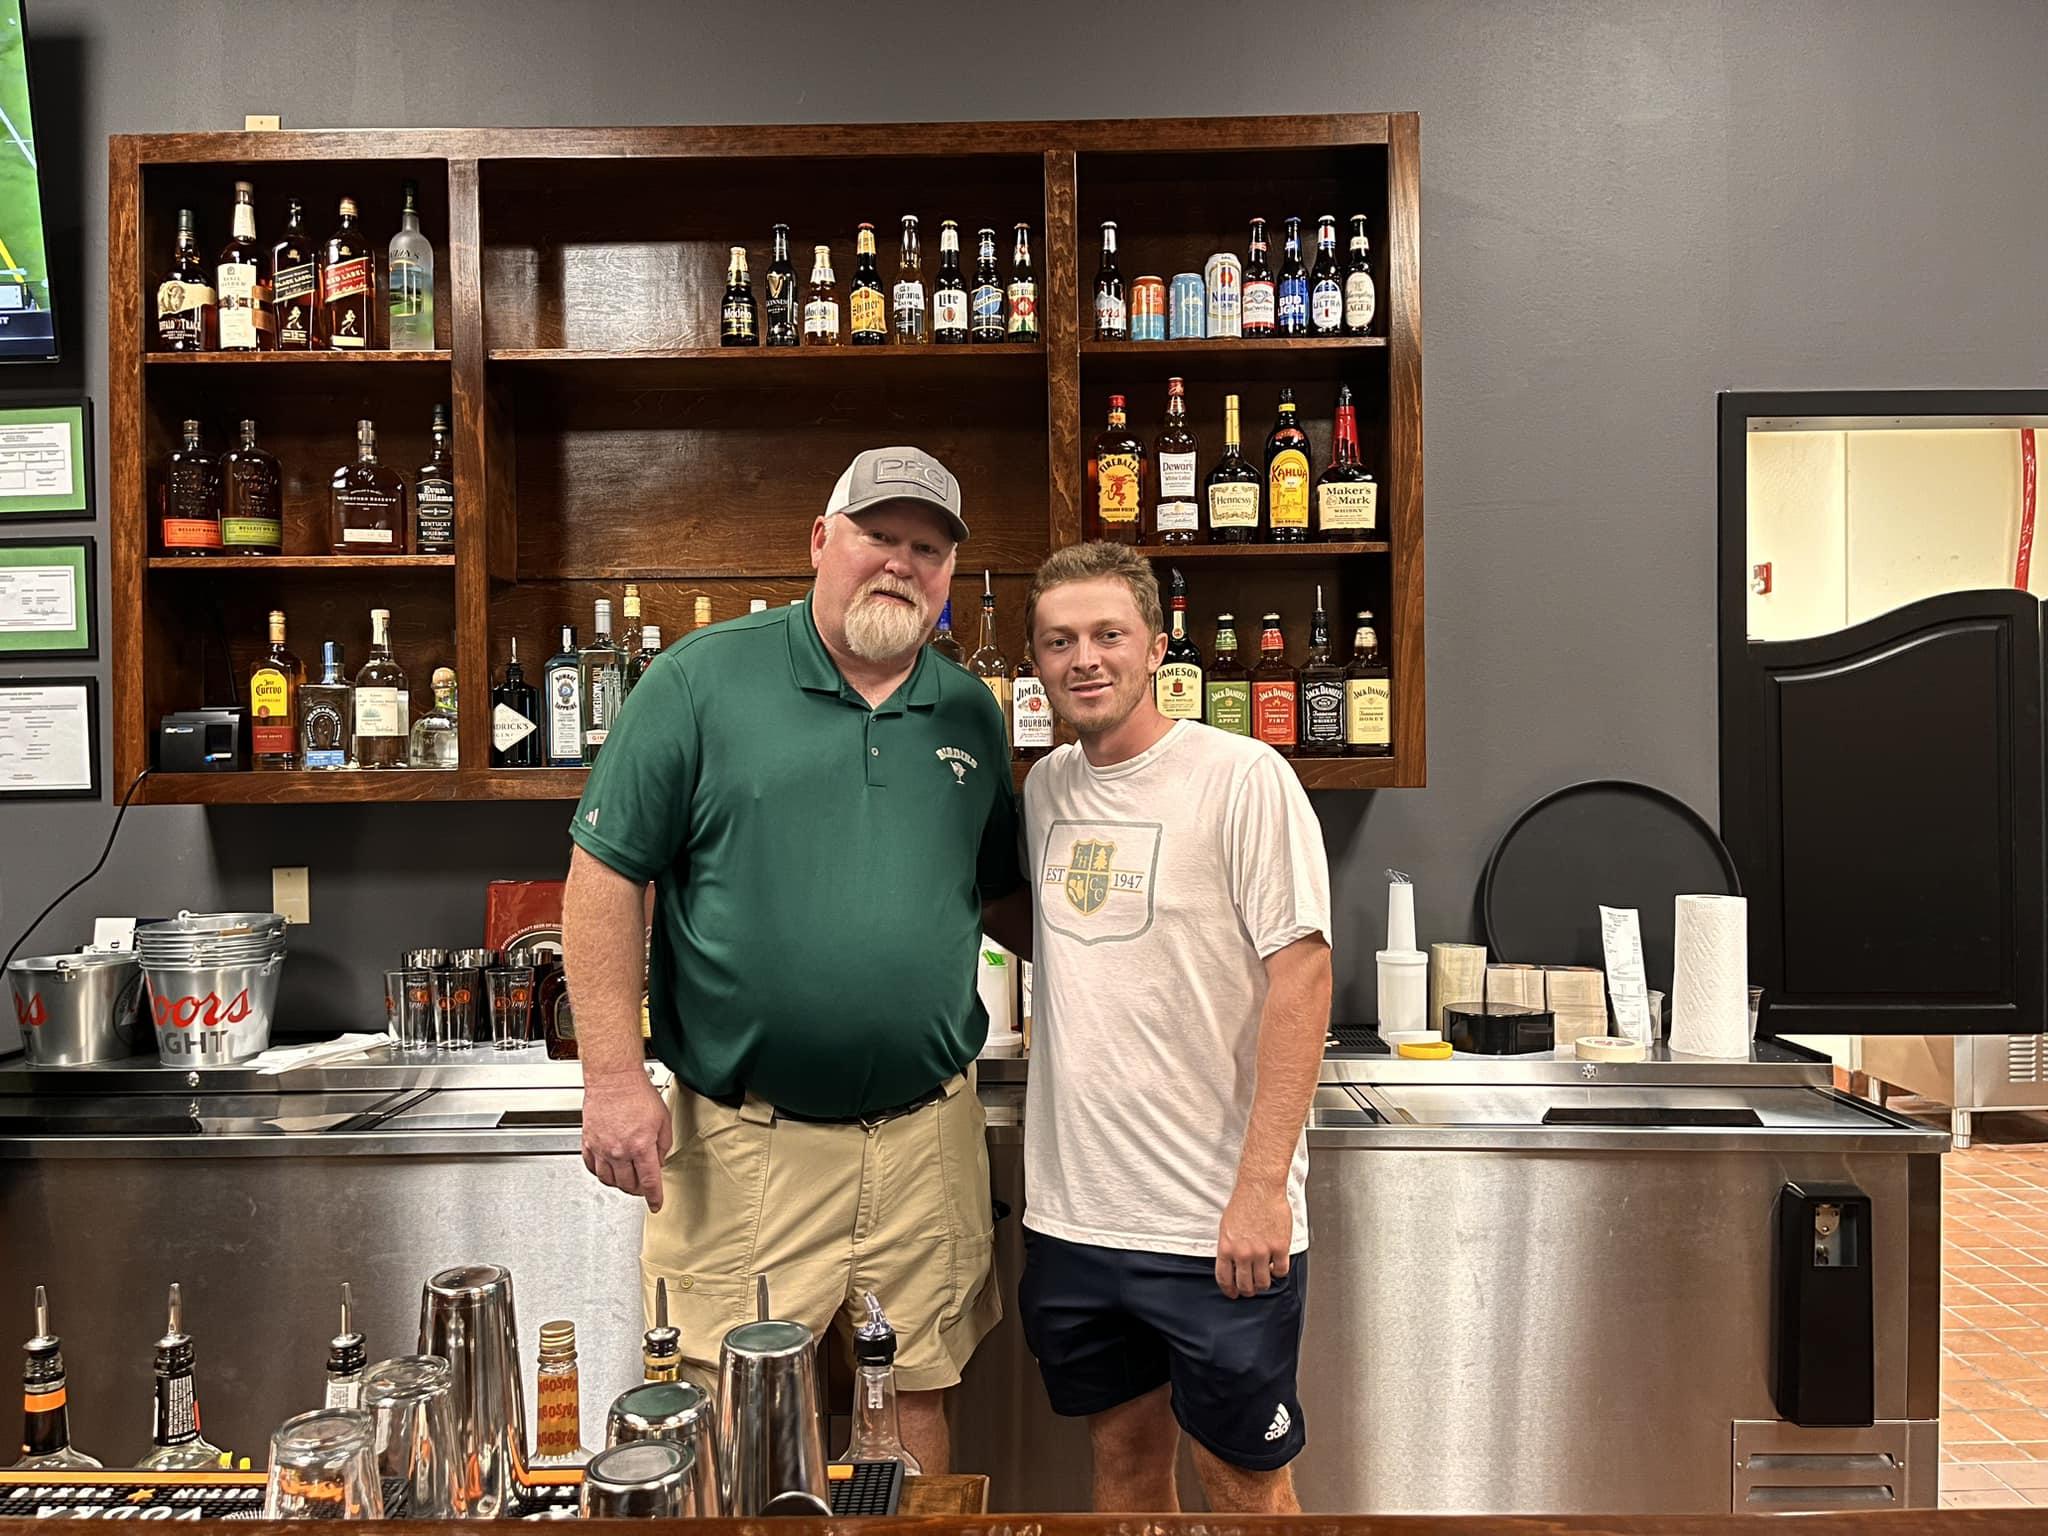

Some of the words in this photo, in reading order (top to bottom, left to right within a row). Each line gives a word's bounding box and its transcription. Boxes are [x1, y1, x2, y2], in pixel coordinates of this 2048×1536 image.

[939, 293, 959, 308] Lite
[723, 307, 753, 320] Modelo
[1099, 457, 1138, 474] FIREBALL
[424, 485, 447, 494] Evan
[1326, 487, 1371, 496] Maker's
[417, 493, 454, 502] Williams
[1216, 496, 1252, 506] Hennessy
[1338, 496, 1370, 505] Mark
[1158, 667, 1199, 681] JAMESON
[255, 684, 282, 697] Cuervo
[1016, 687, 1031, 702] JIM
[1018, 718, 1052, 728] BOURBON
[1046, 867, 1065, 882] EST
[1113, 873, 1143, 889] 1947
[146, 977, 253, 1029] oors
[9, 1486, 115, 1499] TEXAS
[171, 1487, 260, 1499] USTIN
